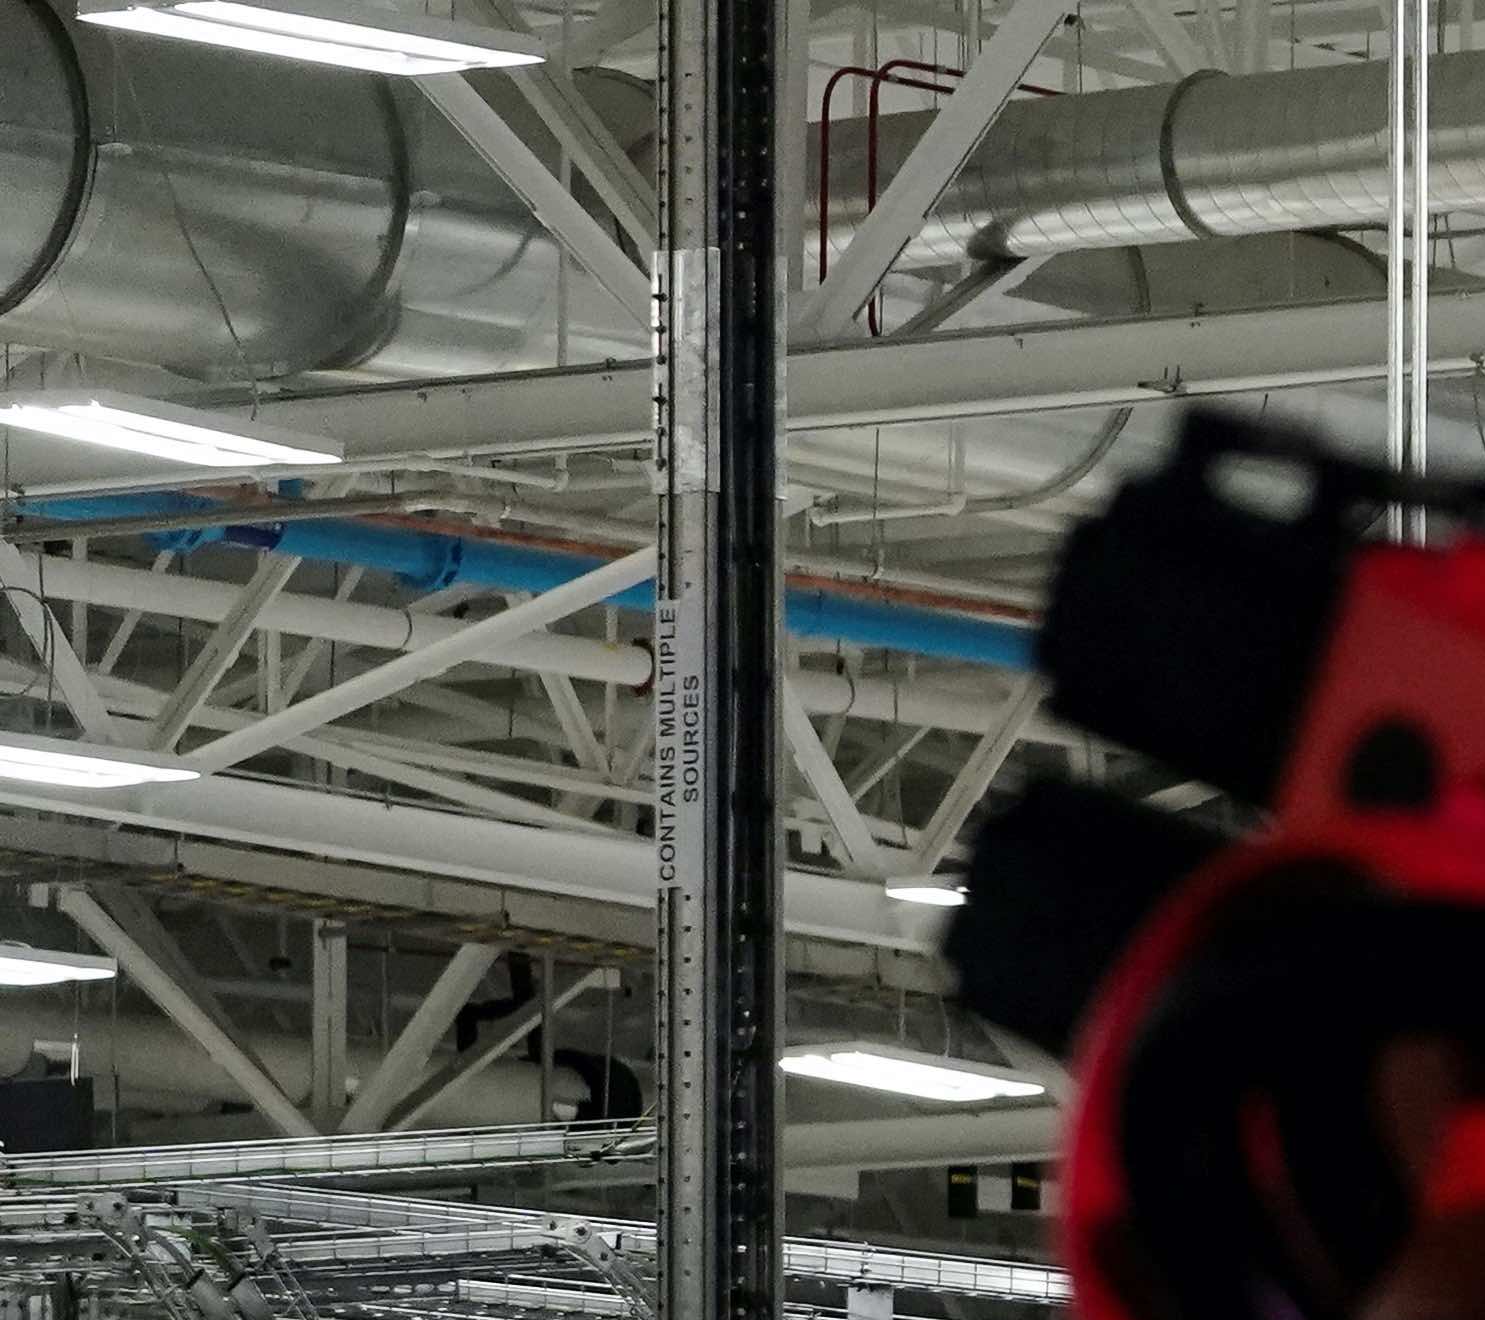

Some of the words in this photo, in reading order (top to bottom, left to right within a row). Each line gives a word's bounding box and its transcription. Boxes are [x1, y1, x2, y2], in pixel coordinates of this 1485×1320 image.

[659, 607, 677, 737] MULTIPLE
[683, 674, 700, 803] SOURCES
[659, 745, 677, 881] CONTAINS
